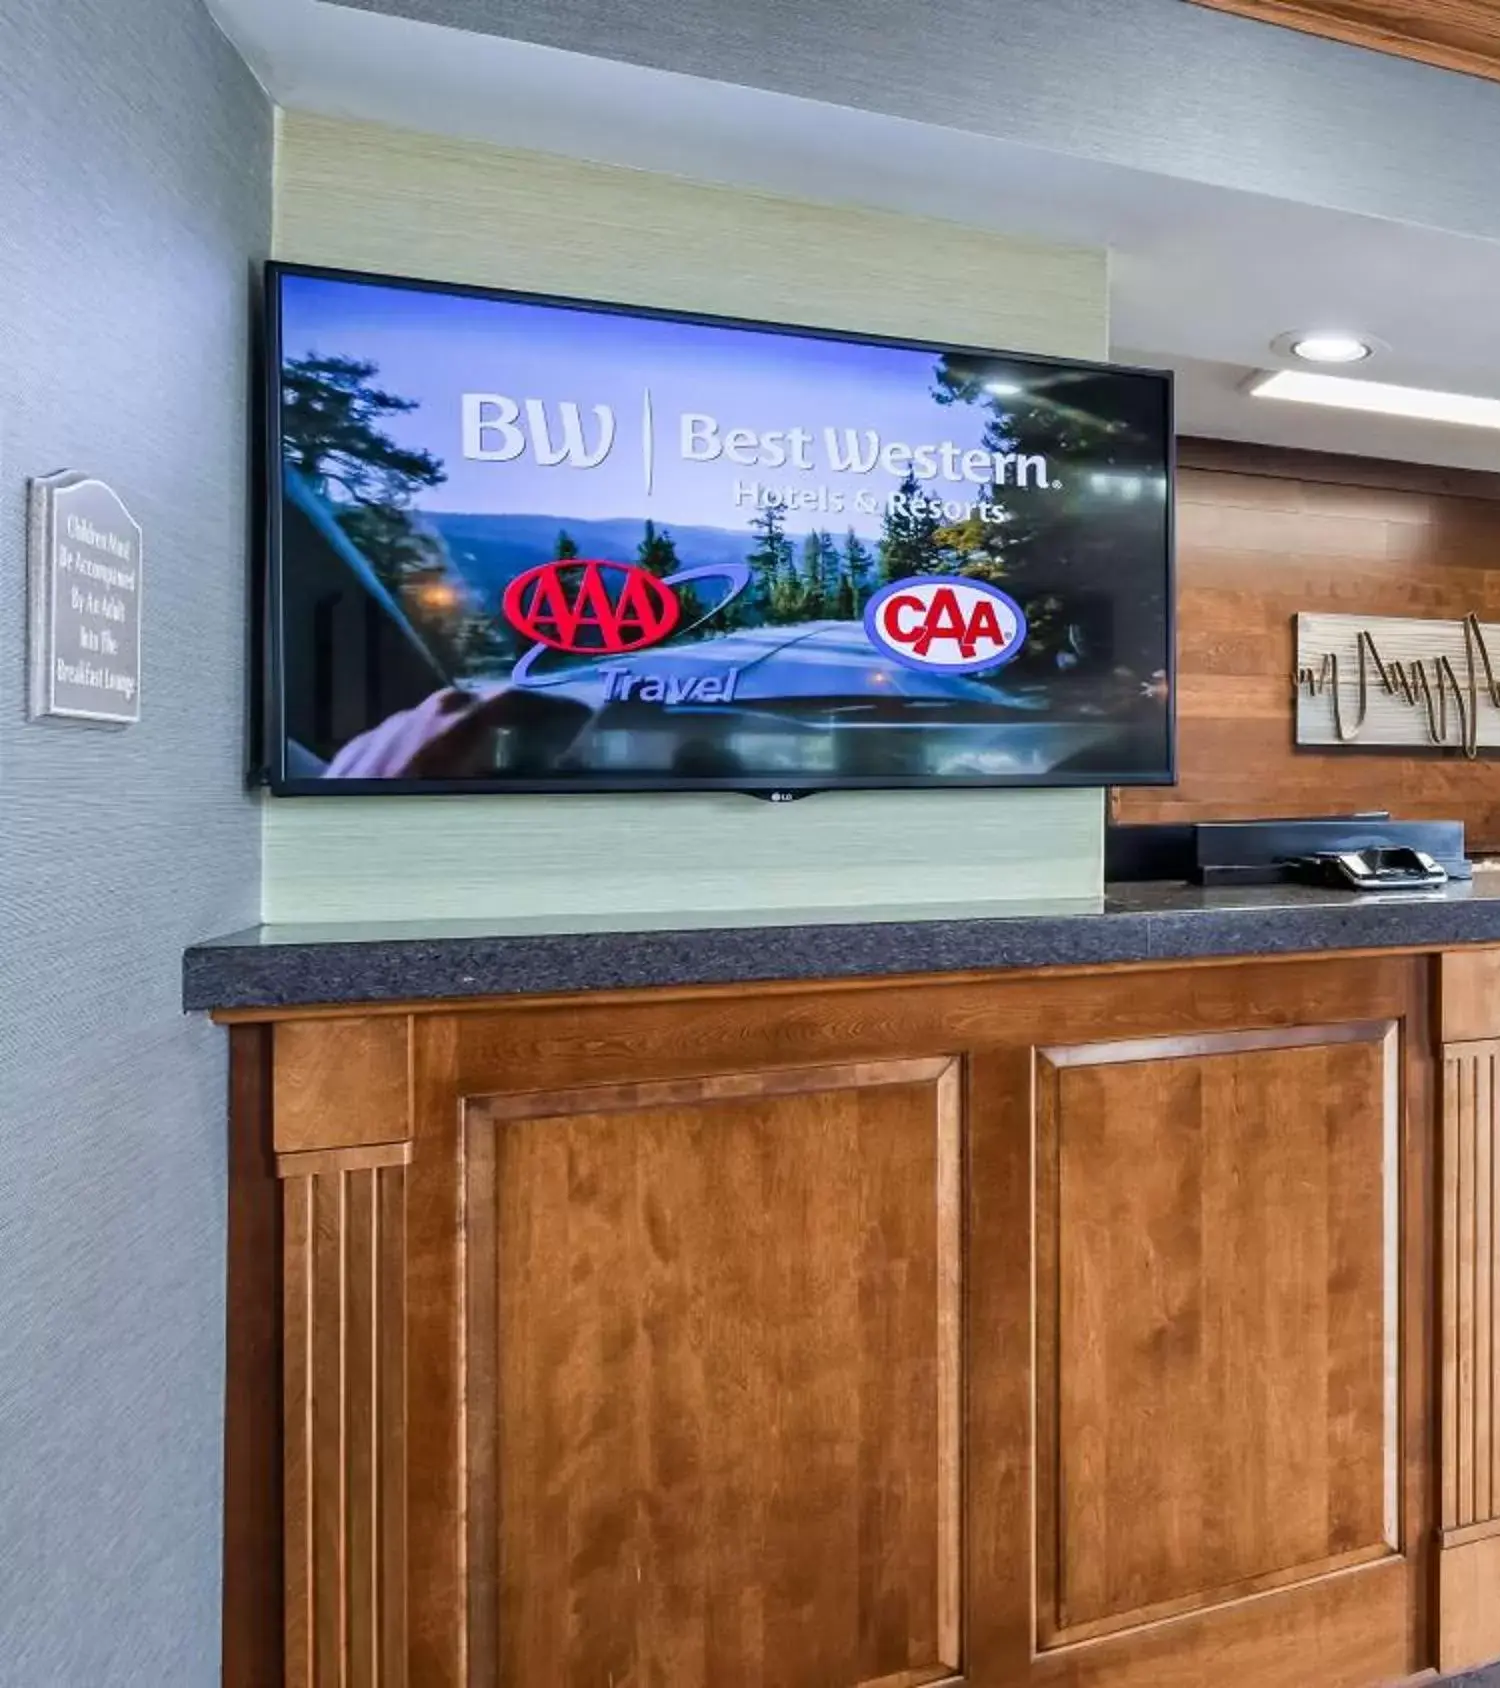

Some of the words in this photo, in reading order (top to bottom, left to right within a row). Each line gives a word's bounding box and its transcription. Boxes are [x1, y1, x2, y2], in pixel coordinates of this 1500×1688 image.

[461, 392, 617, 470] BW
[680, 412, 815, 470] Best
[823, 427, 1051, 490] Western
[734, 478, 846, 514] Hotels
[853, 487, 878, 515] &
[888, 490, 1007, 525] Resorts
[71, 585, 84, 615] By
[522, 559, 666, 654] AAA
[884, 587, 1005, 659] CAA
[57, 657, 103, 689] Breakfast
[598, 667, 739, 704] Travel
